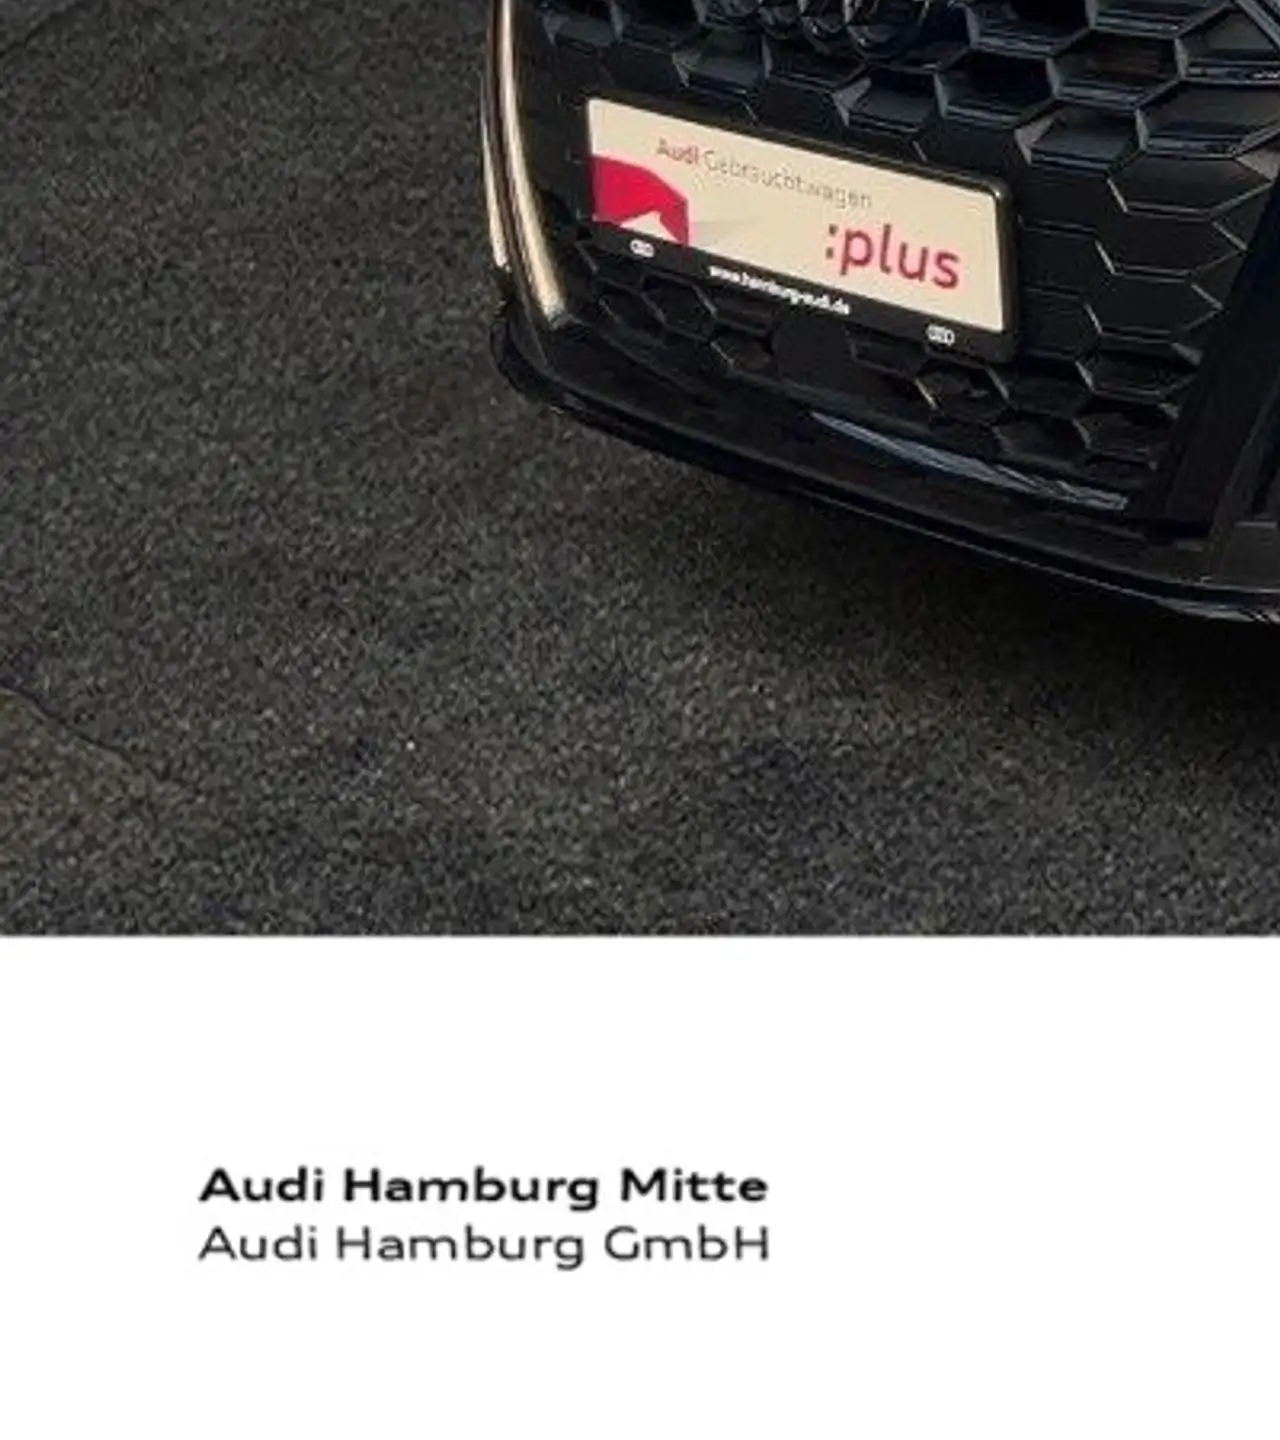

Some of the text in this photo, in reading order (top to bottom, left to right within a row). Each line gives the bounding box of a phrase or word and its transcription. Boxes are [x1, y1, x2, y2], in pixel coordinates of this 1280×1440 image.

[655, 137, 873, 210] Audi Gebrauchtwagen
[825, 222, 960, 290] :plus
